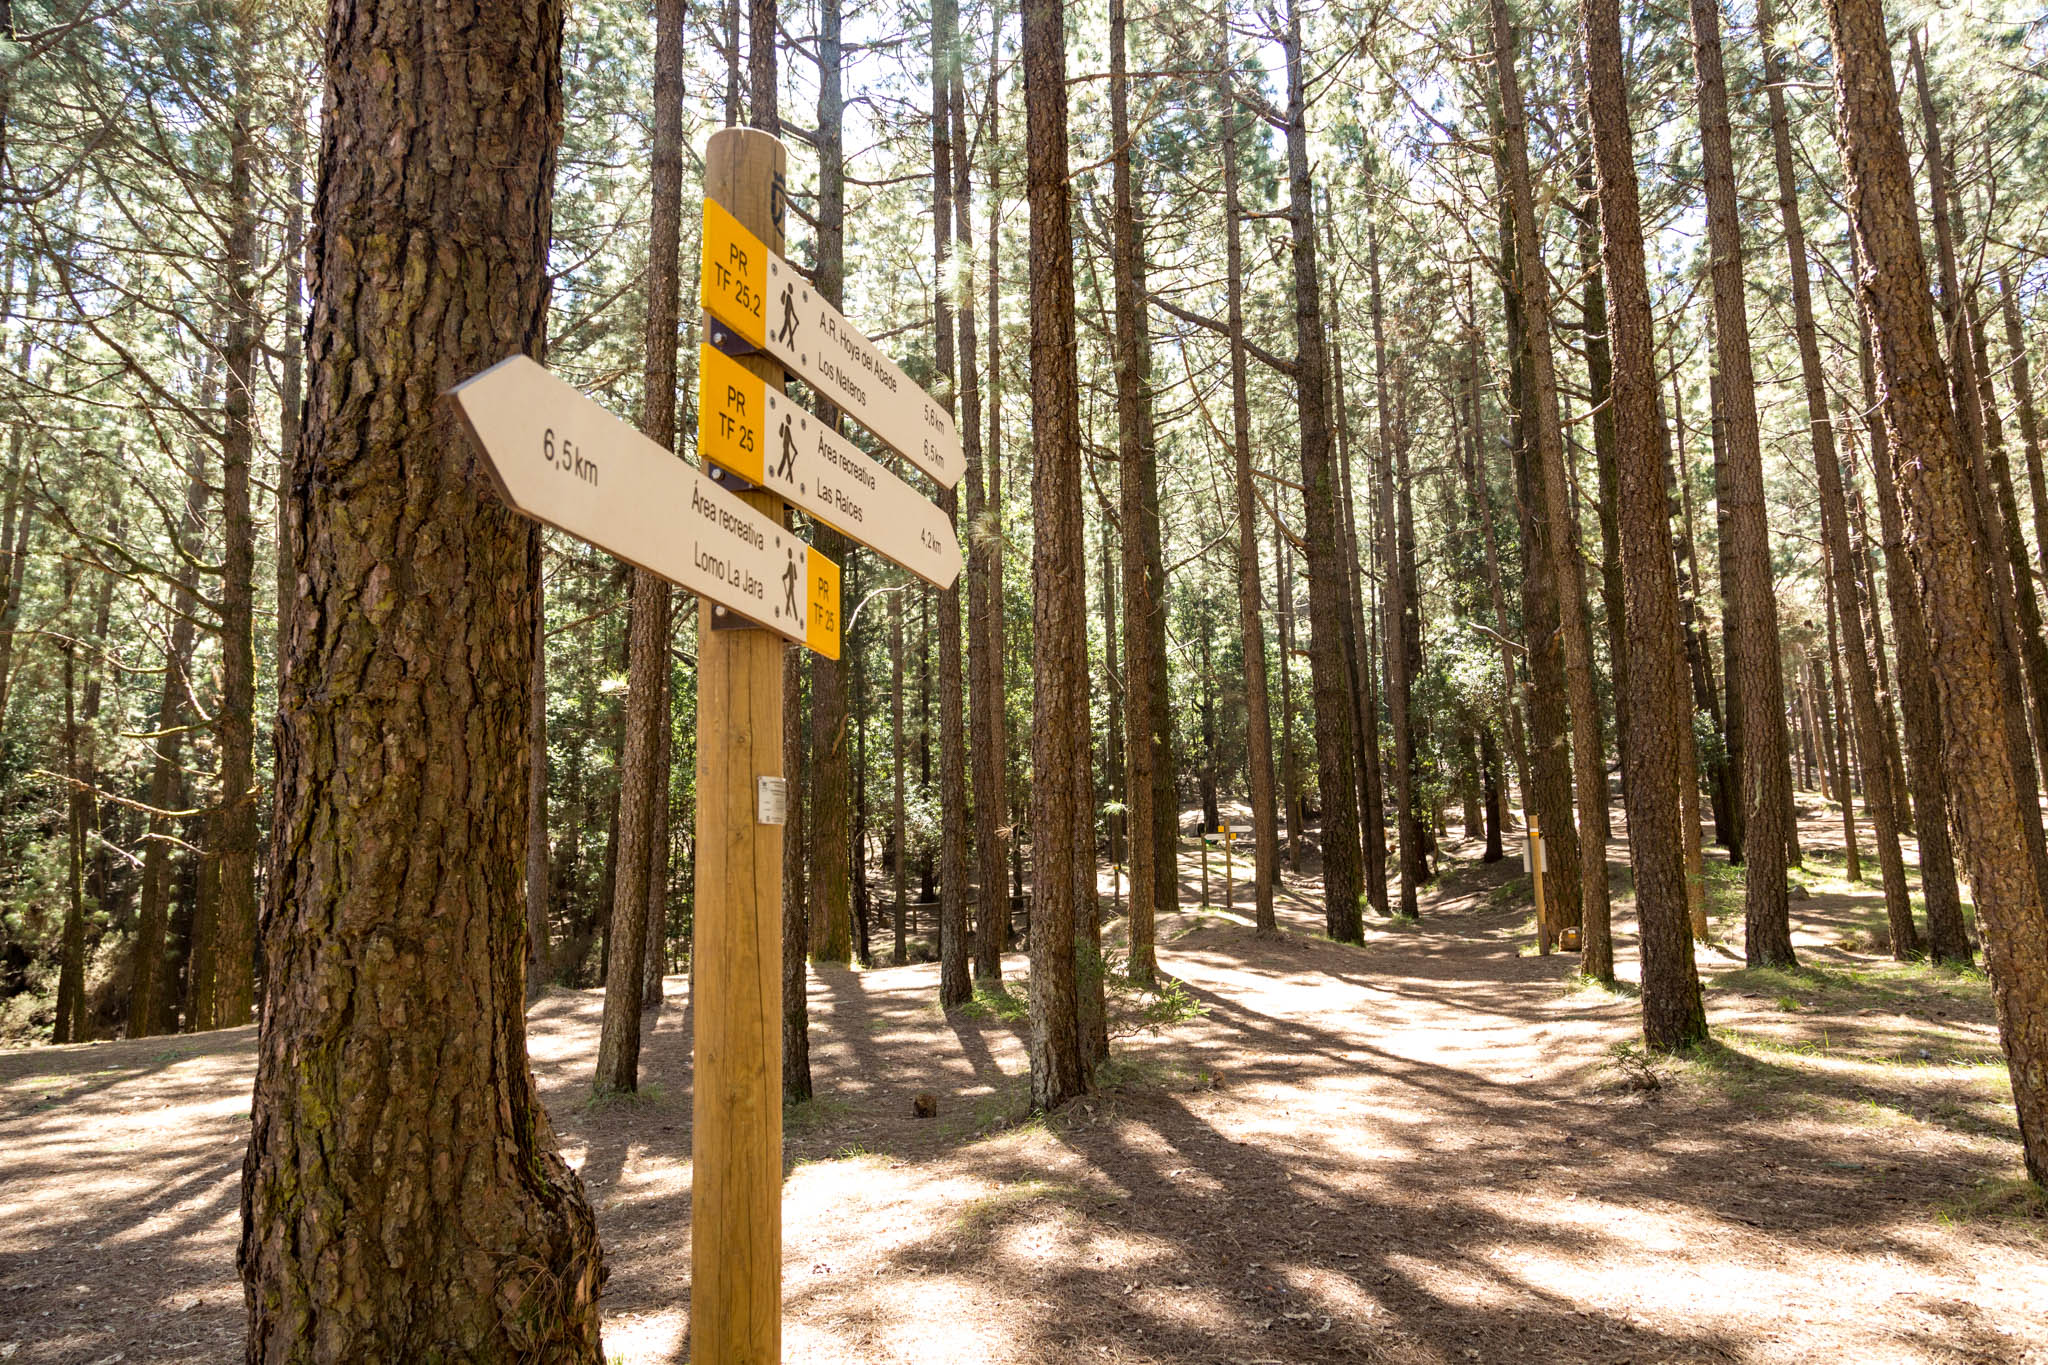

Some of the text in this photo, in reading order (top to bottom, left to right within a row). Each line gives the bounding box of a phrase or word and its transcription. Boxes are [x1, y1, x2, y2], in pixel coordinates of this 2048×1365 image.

[730, 242, 748, 277] PR
[714, 261, 761, 318] TF 25.2
[820, 311, 897, 393] A.R. Hoya del Abade
[727, 384, 746, 417] PR
[818, 351, 866, 407] Los Nateros
[718, 410, 754, 453] TF 25
[817, 429, 876, 491] Área recreativa
[691, 479, 764, 551] Área recreativa
[817, 477, 833, 505] Las
[694, 540, 763, 600] Lomo La Jara
[818, 576, 829, 603] PR
[813, 602, 834, 633] TF 25
